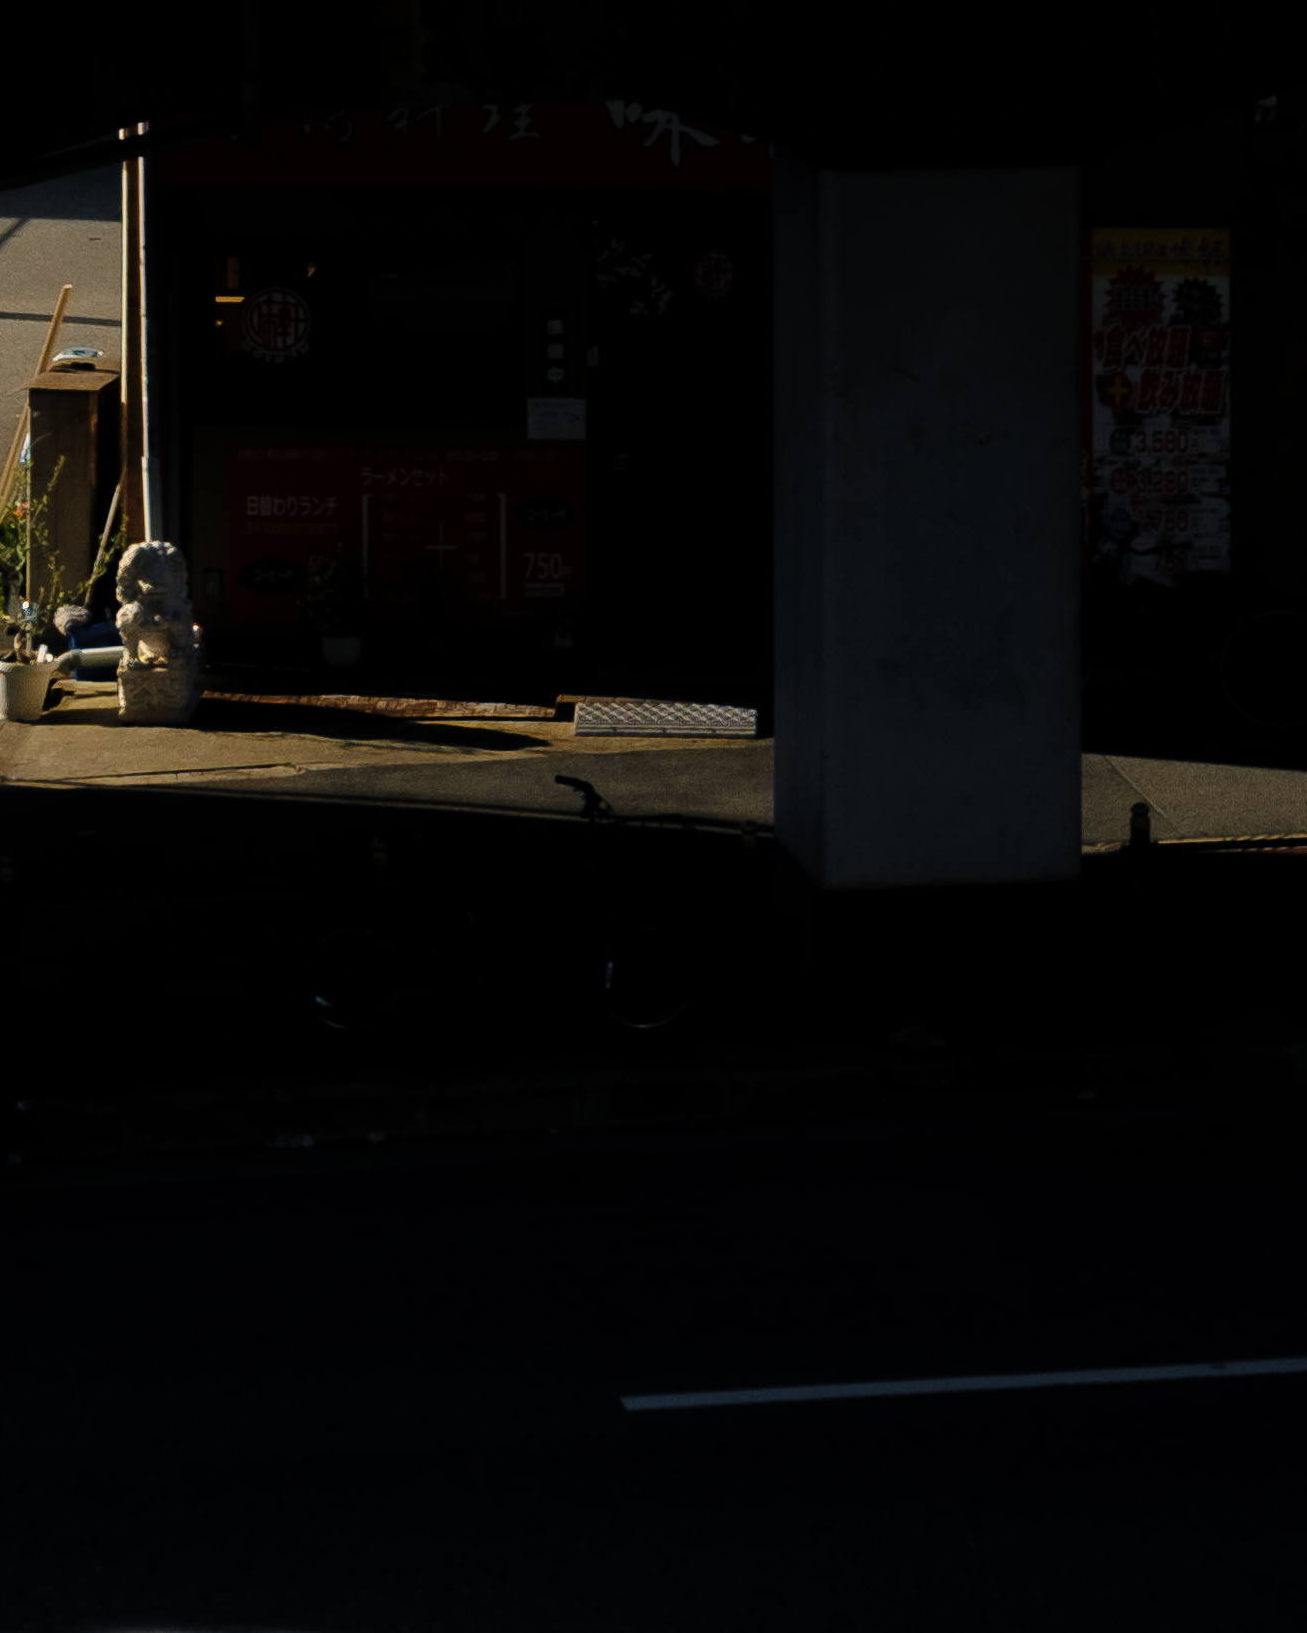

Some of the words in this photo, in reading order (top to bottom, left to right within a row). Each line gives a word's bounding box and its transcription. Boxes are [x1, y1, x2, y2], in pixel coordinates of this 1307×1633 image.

[359, 465, 450, 489] ラーメンセット
[245, 494, 339, 518] 日替わりランチ
